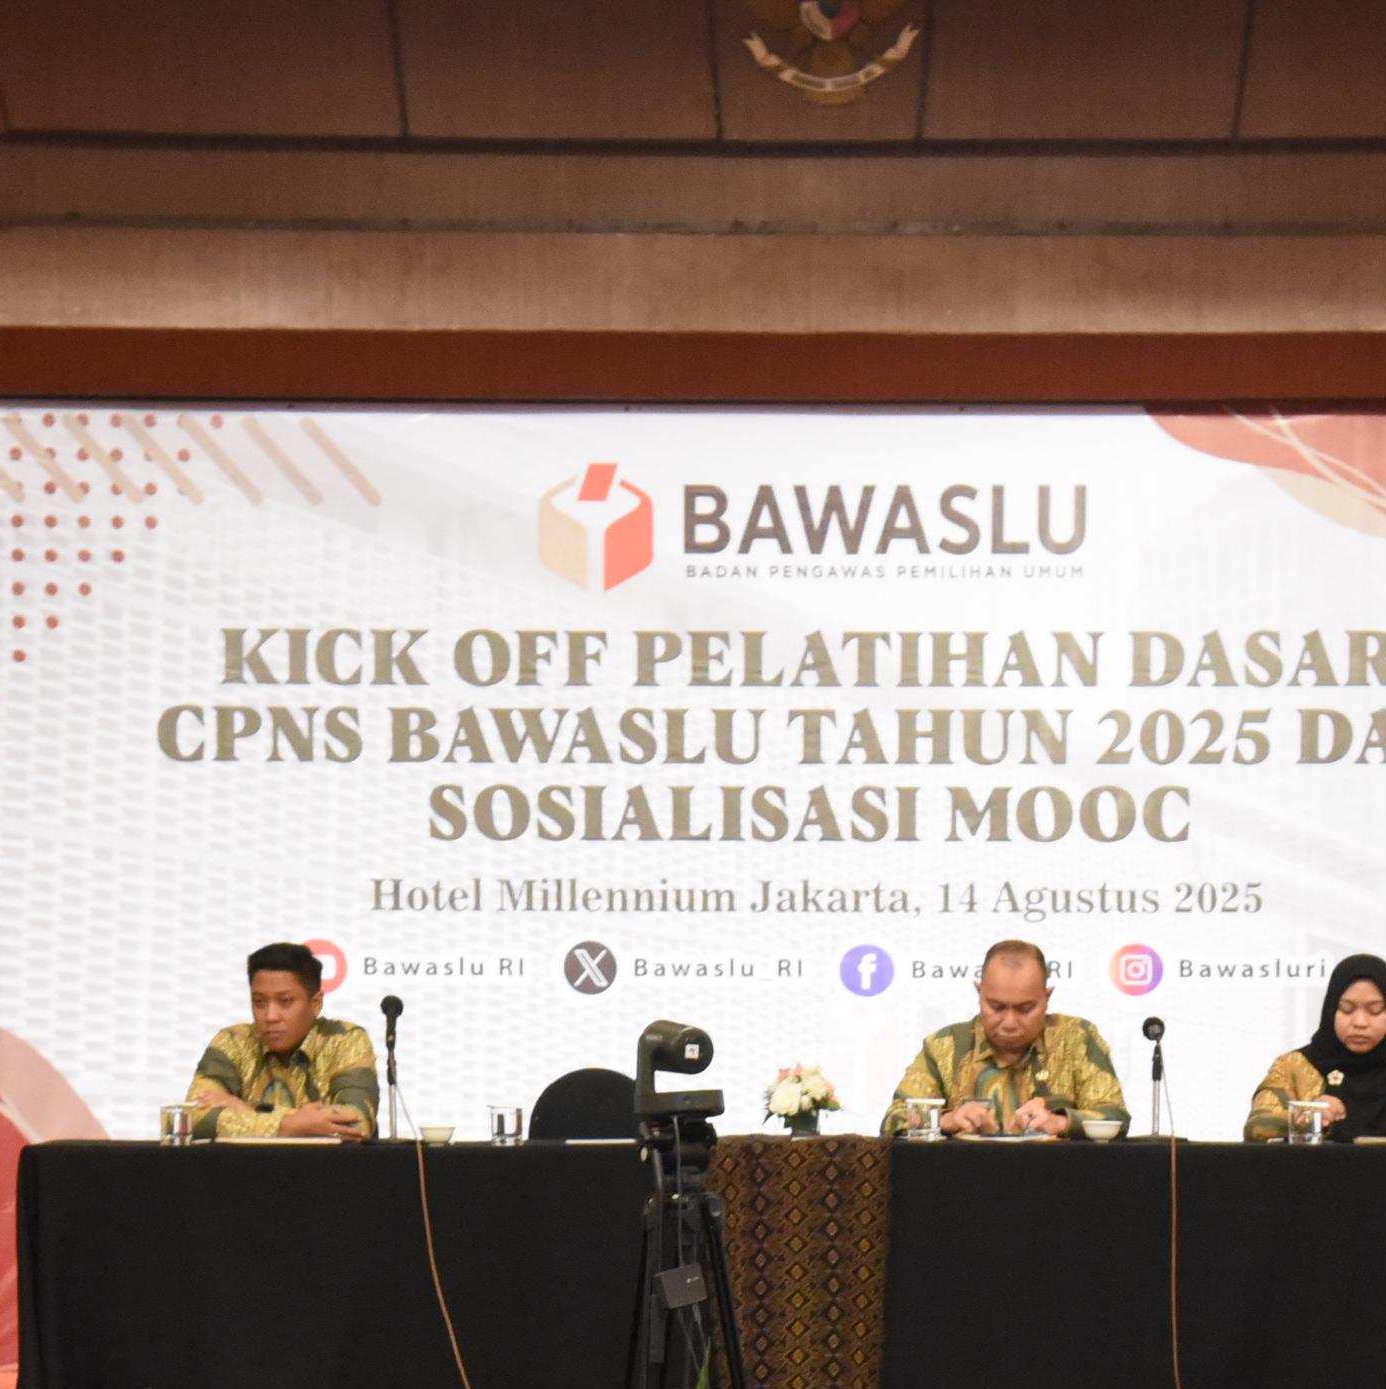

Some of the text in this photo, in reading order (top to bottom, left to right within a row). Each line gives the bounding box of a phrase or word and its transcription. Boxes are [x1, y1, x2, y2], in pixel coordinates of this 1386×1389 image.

[682, 483, 1088, 555] BAWASLU
[685, 563, 1085, 580] BADAN PENGAWAS PEMILIHAN UMUM
[220, 627, 431, 687] KICK
[452, 628, 609, 688] OFF
[632, 629, 1104, 689] PELATIHAN
[156, 703, 364, 764] CPNS
[387, 705, 768, 766] BAWASLU
[785, 706, 1074, 766] TAHUN
[1094, 707, 1273, 766] 2025
[428, 783, 1191, 843] SOSIALISASI MOOC
[370, 877, 1265, 923] Hotel Millennium Jakarta, 14 Agustus 2025
[362, 955, 525, 978] Bawaslu RI
[911, 959, 1073, 980] Bawa RI
[1178, 958, 1327, 980] Bawasluri
